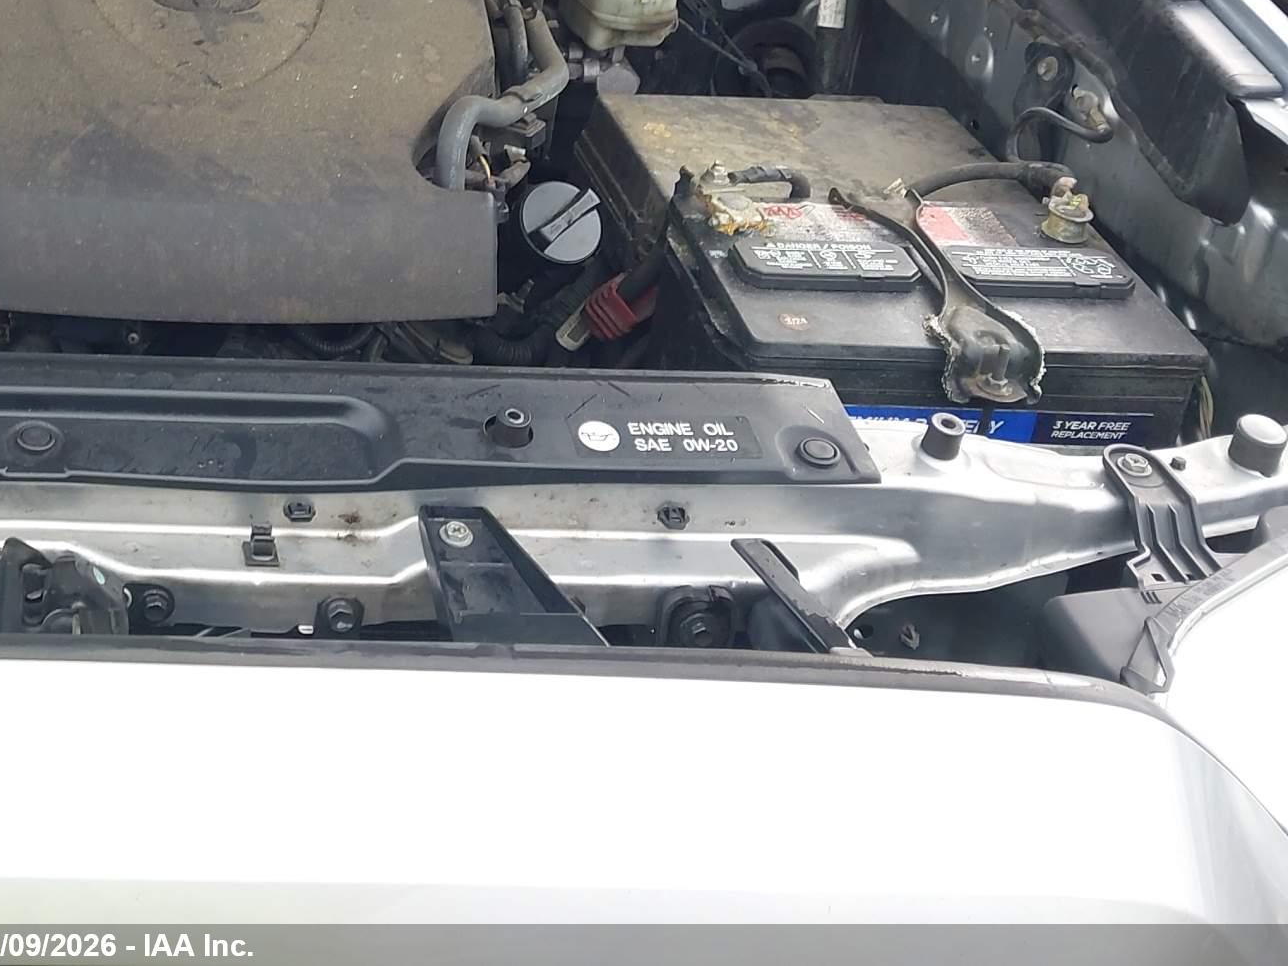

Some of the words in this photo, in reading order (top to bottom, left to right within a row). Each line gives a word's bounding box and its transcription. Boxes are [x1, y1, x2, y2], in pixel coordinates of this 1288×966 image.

[627, 422, 694, 436] ENGINE
[703, 422, 734, 436] OIL
[1052, 420, 1064, 430] 3
[1064, 420, 1097, 430] YEAR
[1097, 421, 1131, 431] FREE
[1050, 430, 1127, 440] REPLACEMENT
[634, 437, 672, 452] SAE
[682, 438, 739, 452] 0W-20
